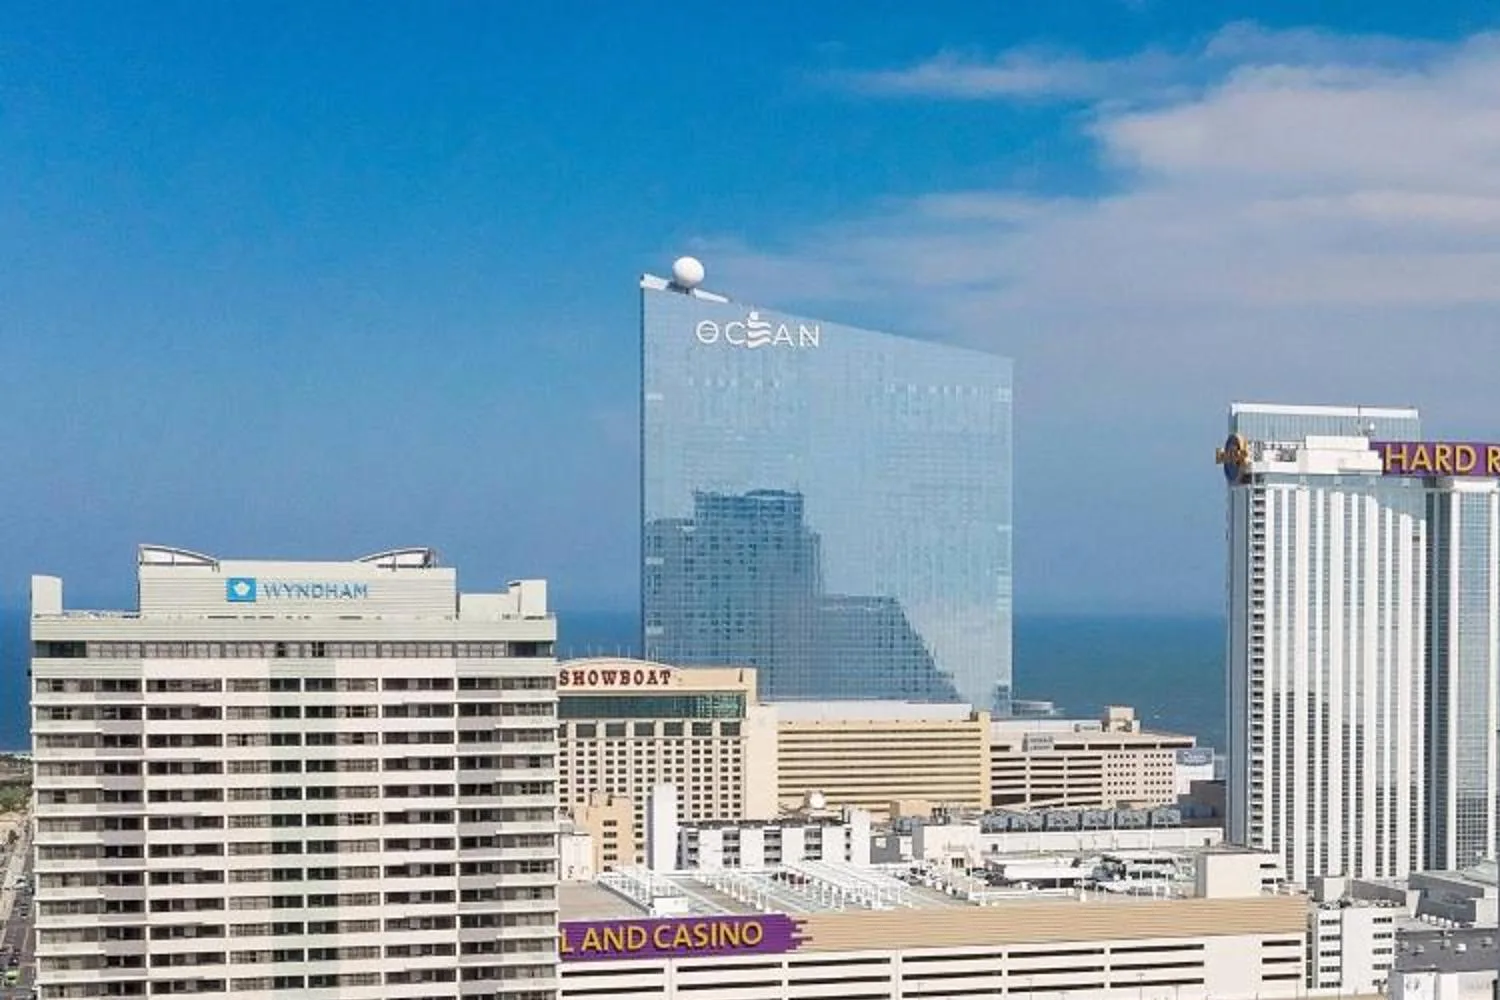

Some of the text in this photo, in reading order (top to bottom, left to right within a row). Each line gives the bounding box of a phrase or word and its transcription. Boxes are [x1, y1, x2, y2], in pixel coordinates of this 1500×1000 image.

[696, 311, 820, 348] OCEAN
[1385, 443, 1477, 473] HARD
[264, 582, 367, 599] WYNDHAM
[559, 669, 671, 686] SHOWBOAT
[581, 925, 648, 951] AND
[654, 921, 763, 948] CASINO
